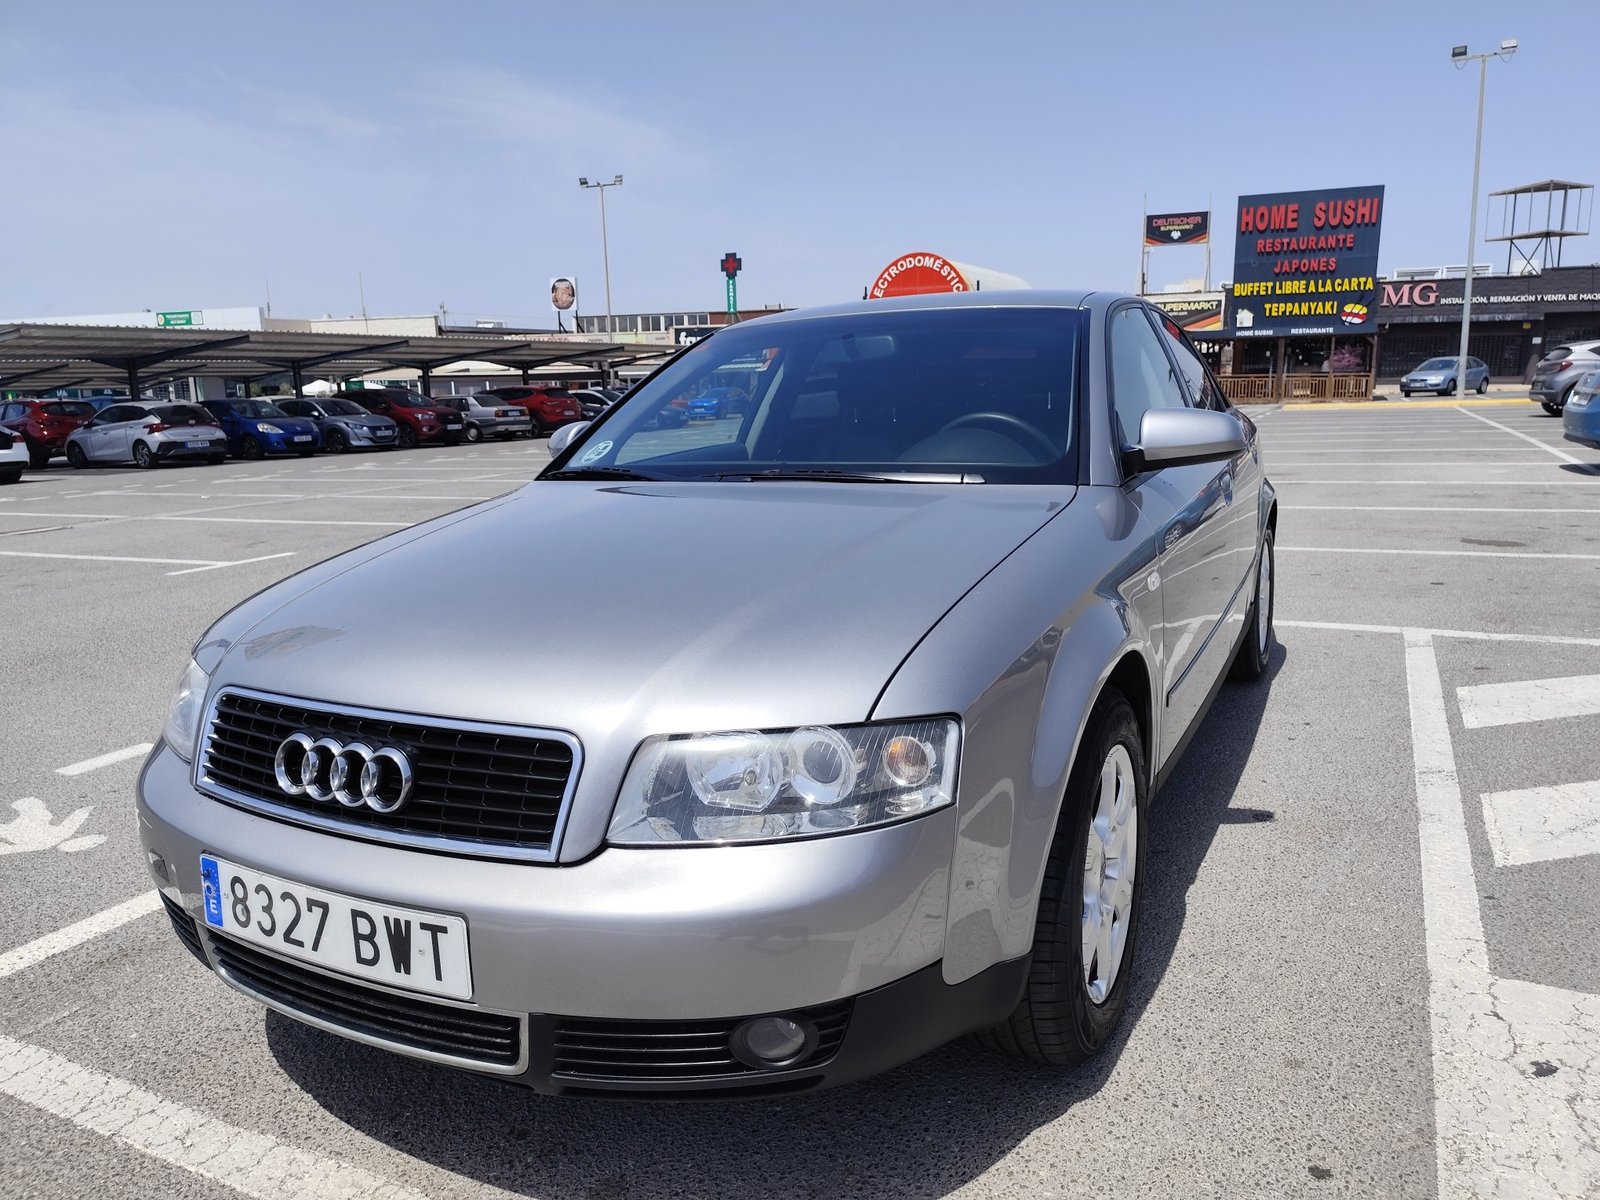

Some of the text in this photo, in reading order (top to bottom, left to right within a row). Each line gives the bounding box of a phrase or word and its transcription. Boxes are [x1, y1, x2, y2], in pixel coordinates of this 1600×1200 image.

[1152, 216, 1202, 227] DEUTSCHER
[1240, 197, 1379, 232] HOME SUSHI
[1160, 224, 1194, 232] SUPERMARKT
[1256, 233, 1354, 253] RESTAURANTE
[1273, 257, 1337, 274] JAPONES
[1233, 276, 1374, 297] BUFFET LIBRE A LA CARTA
[1380, 282, 1440, 306] MG
[1489, 293, 1536, 303] REPARACIÓN
[1536, 294, 1543, 302] Y
[1543, 293, 1566, 302] VENTA
[1568, 293, 1578, 301] DE
[1264, 301, 1338, 317] TEPPANYAKI
[209, 899, 218, 914] E
[230, 875, 448, 982] 8327 BWT
